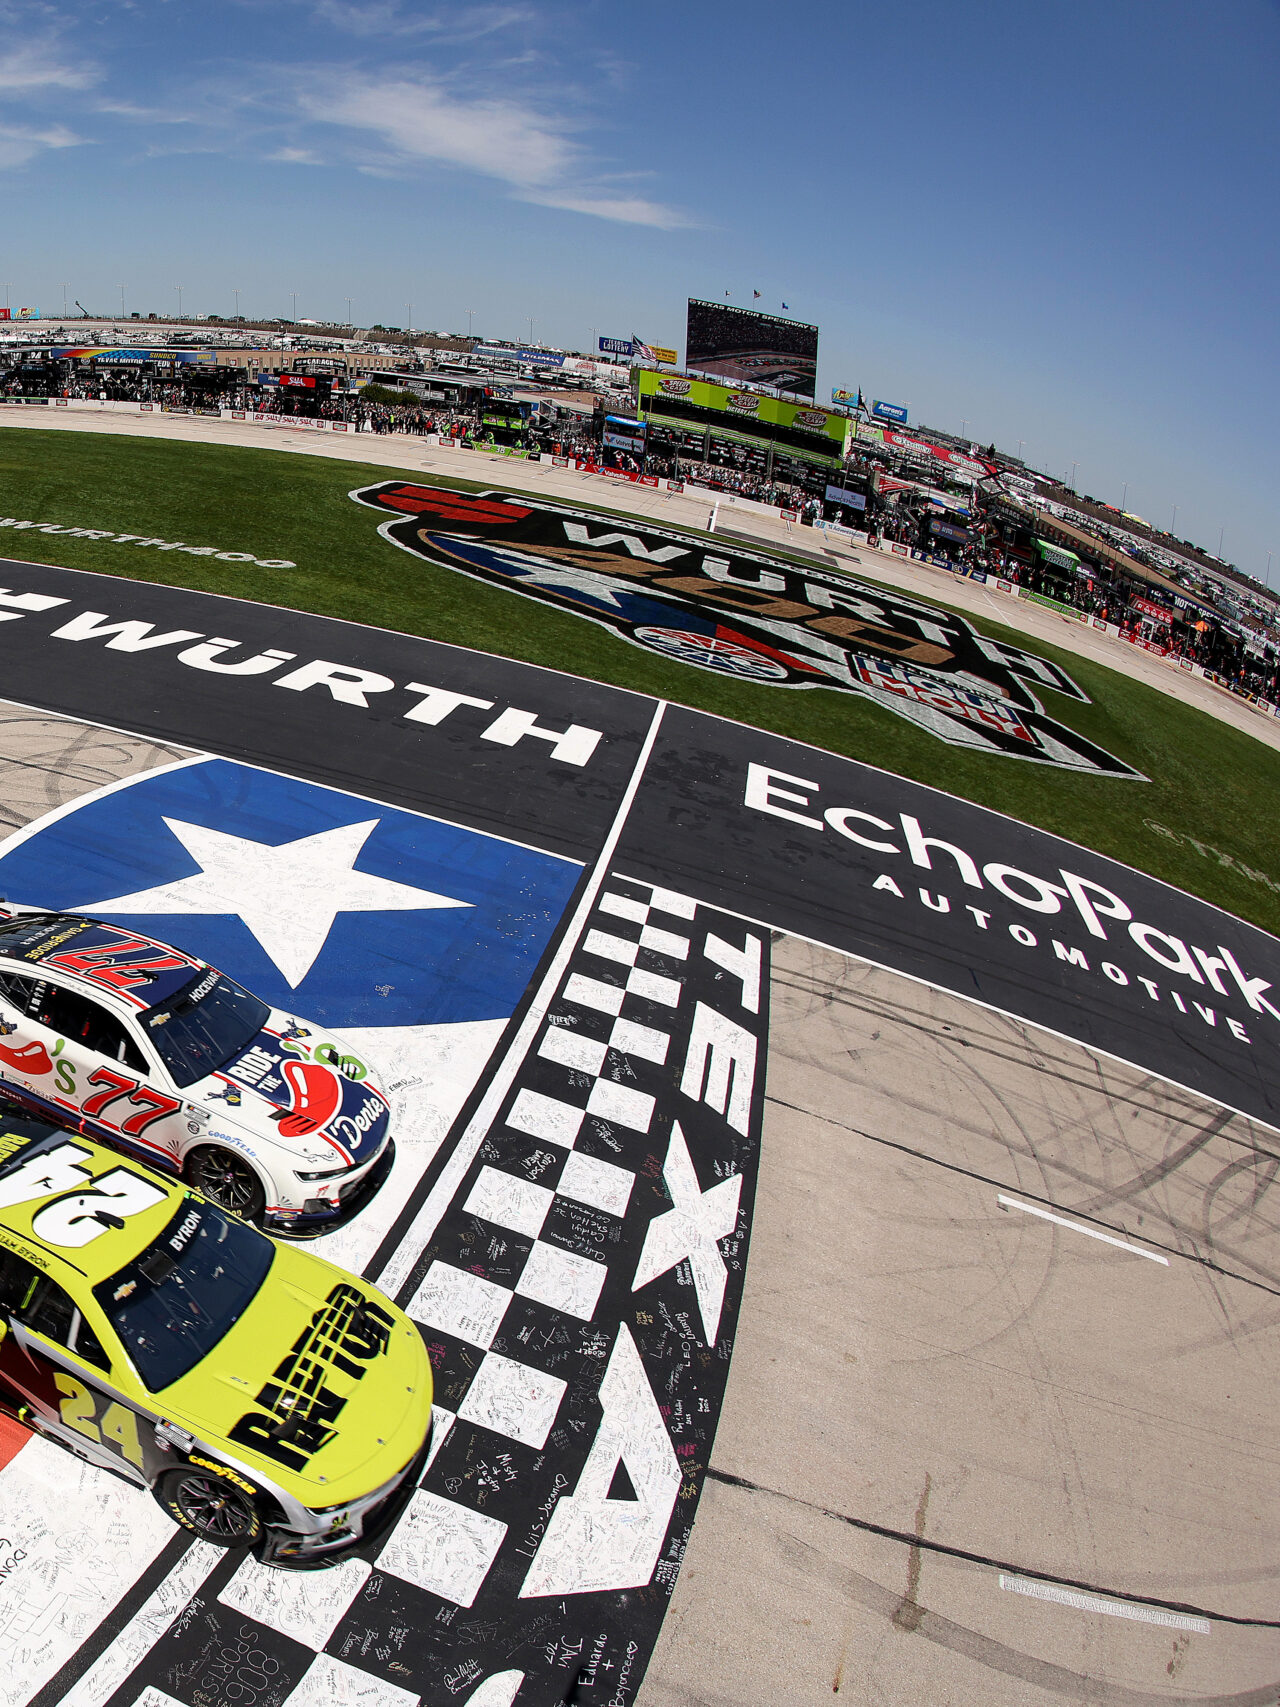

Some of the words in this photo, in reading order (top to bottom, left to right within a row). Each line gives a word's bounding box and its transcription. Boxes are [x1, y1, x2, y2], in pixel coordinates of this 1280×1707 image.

[696, 301, 725, 310] TEXAS
[726, 306, 760, 318] MOTOR
[761, 314, 809, 329] SPEEDWAY
[604, 470, 631, 481] Valvoline
[862, 657, 1014, 722] LIQUI
[867, 671, 1025, 736] MOLY
[743, 761, 1280, 1020] EchoPark
[24, 926, 84, 961] GAINBRIDGE
[42, 937, 190, 991] 77
[872, 873, 1253, 1045] AUTOMOTIVE
[188, 971, 221, 1003] HOCEVAR
[226, 1044, 284, 1086] RIDE
[258, 1072, 284, 1094] THE
[80, 1066, 184, 1138] 77
[207, 1129, 258, 1159] GOODYEAR
[167, 1208, 203, 1253] BYRON
[16, 1246, 51, 1269] BYRON
[462, 931, 763, 1707] TEXA
[226, 1283, 397, 1474] RAPTOR
[54, 1371, 146, 1472] 24
[188, 1453, 258, 1496] GOODYEAR
[475, 1459, 501, 1492] Justin
[495, 1452, 518, 1482] Misty
[169, 1501, 195, 1530] EAGLE
[577, 1632, 609, 1687] Eduardo
